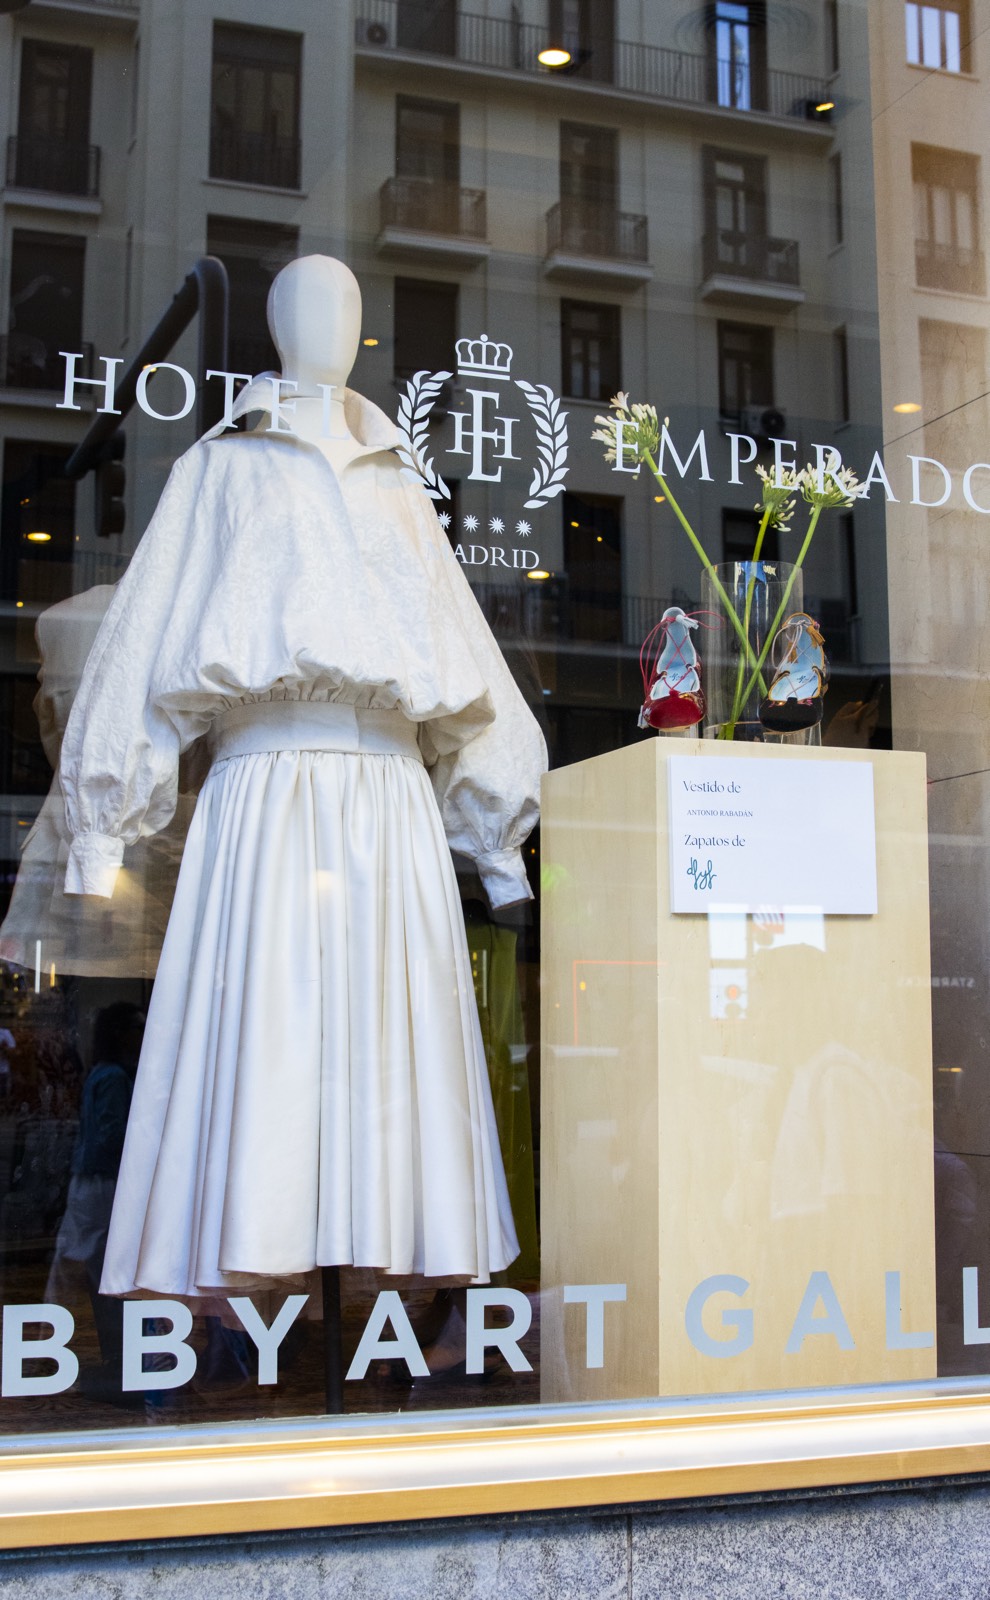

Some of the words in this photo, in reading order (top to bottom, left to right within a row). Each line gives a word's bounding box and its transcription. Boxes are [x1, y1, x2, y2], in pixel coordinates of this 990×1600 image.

[55, 351, 350, 442] HOTEL
[683, 781, 724, 793] Vestido
[727, 782, 741, 793] de
[684, 834, 729, 849] Zapatos
[732, 834, 746, 847] de
